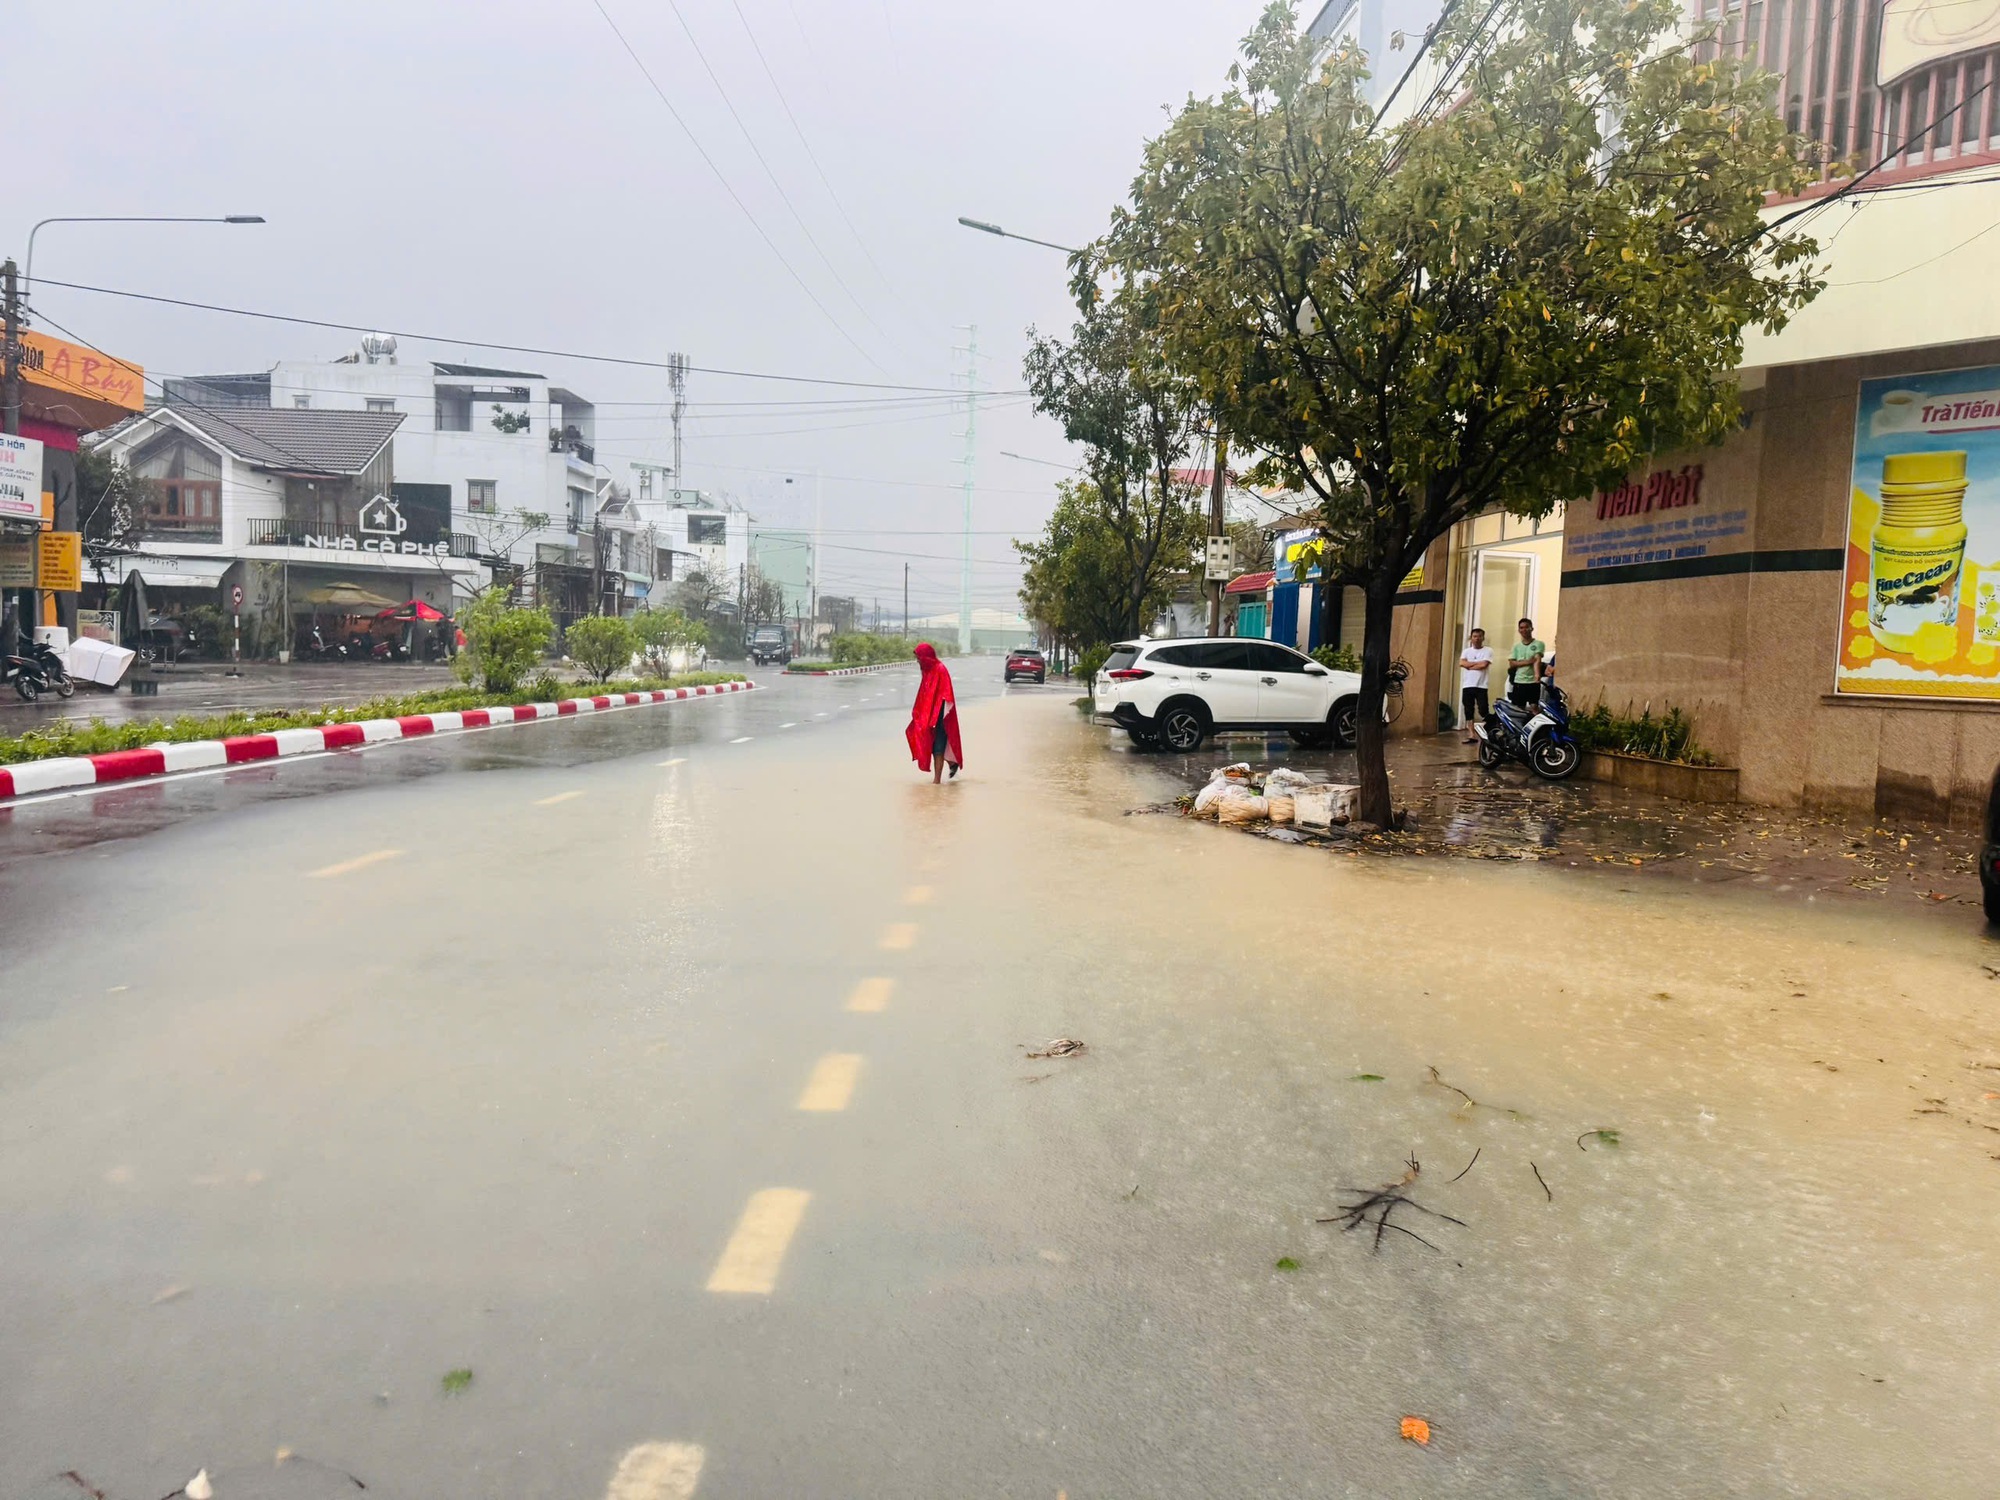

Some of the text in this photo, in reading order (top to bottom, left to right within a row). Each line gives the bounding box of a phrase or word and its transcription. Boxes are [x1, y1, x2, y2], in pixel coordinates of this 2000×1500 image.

[52, 348, 70, 380] A
[7, 440, 25, 450] HÓA
[1642, 464, 1703, 512] Phát
[304, 534, 450, 556] NHÀ CÀ PHÊ
[1876, 560, 1953, 592] FineCacao
